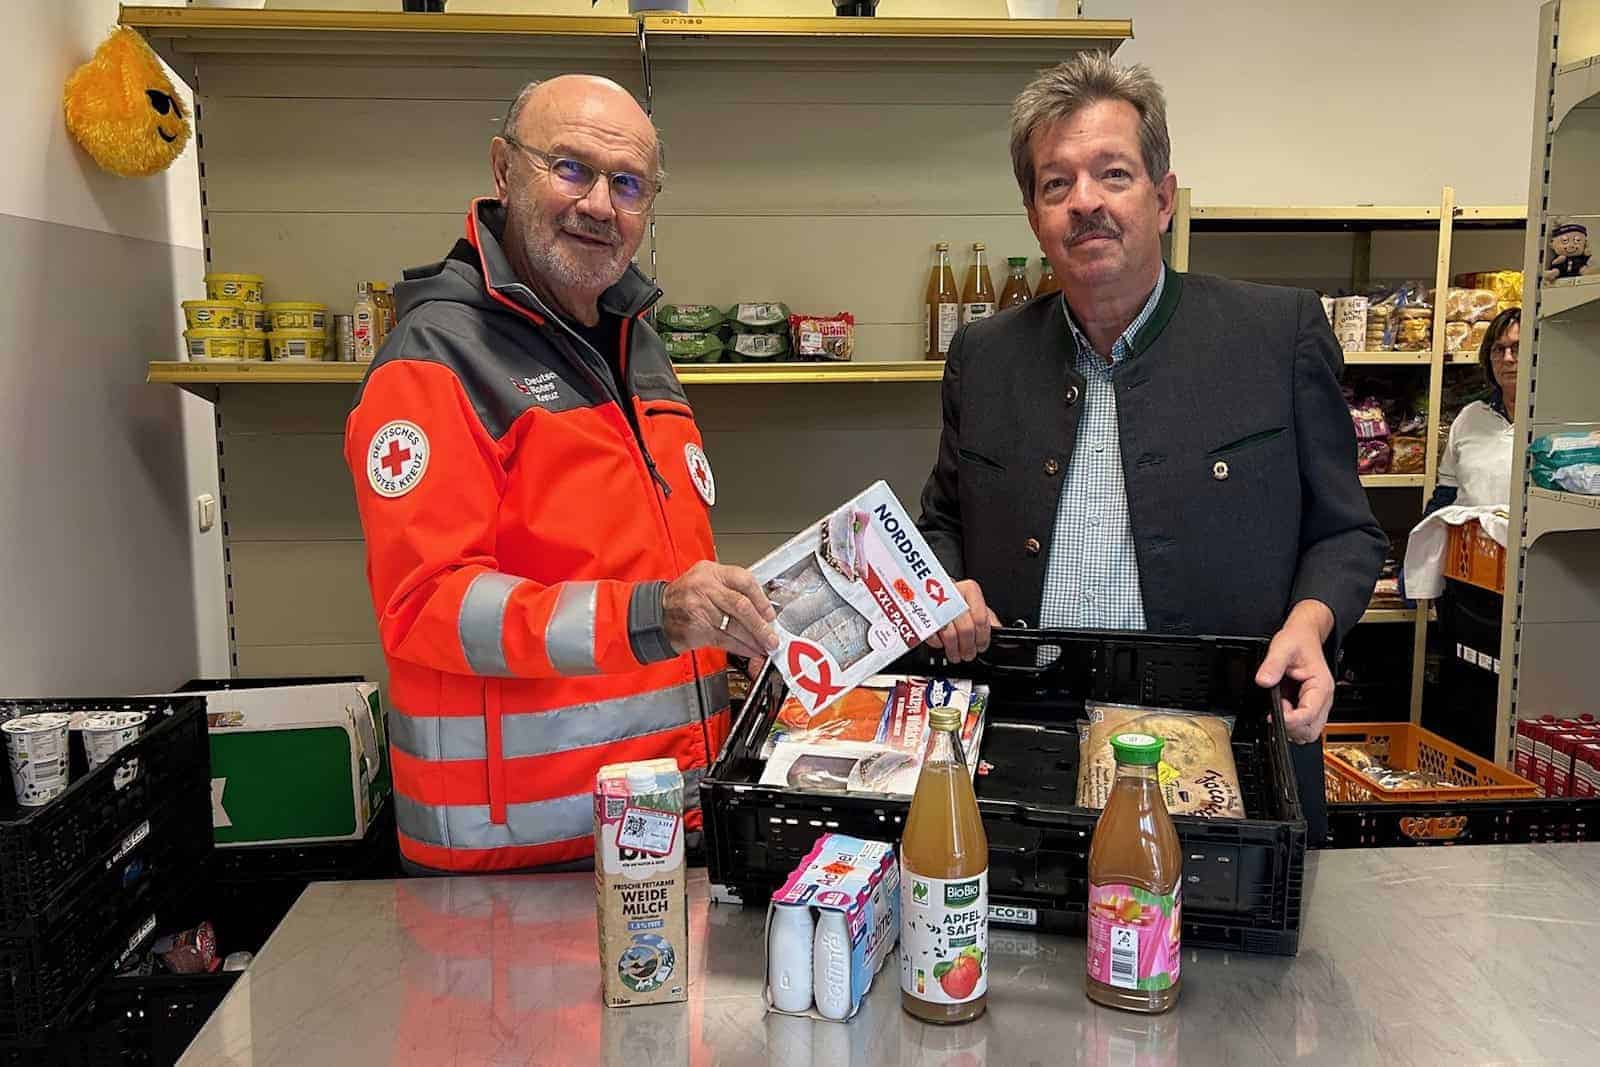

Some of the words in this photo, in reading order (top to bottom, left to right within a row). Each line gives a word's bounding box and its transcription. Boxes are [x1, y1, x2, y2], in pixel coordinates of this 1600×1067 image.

[373, 427, 419, 459] DEUTSCHES
[374, 467, 396, 491] ROTES
[399, 452, 423, 488] KREUZ
[874, 503, 932, 581] NORDSEE
[613, 882, 641, 890] FRISCHE
[642, 879, 675, 889] FETTARME
[946, 885, 978, 898] BioBio
[621, 888, 668, 903] WEIDE
[622, 900, 668, 916] MILCH
[943, 910, 981, 925] APFEL
[947, 922, 978, 936] SAFT
